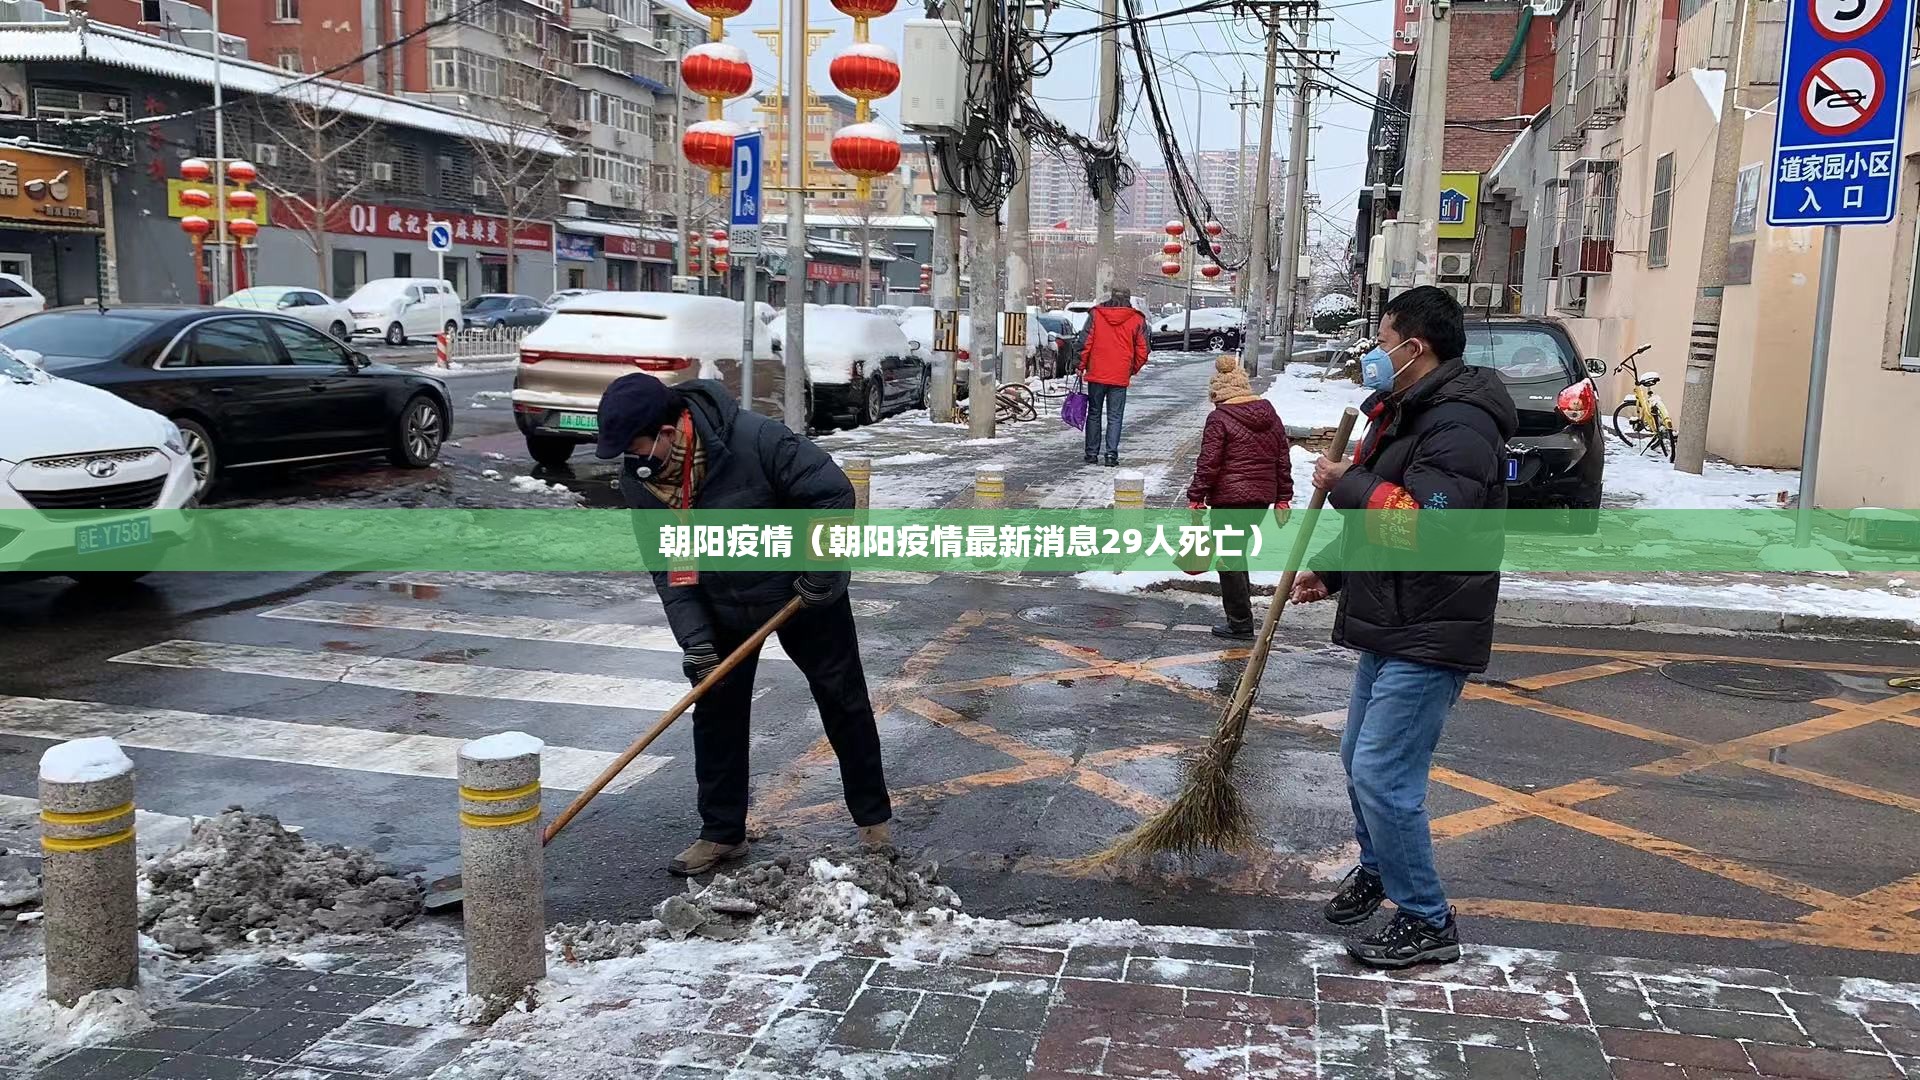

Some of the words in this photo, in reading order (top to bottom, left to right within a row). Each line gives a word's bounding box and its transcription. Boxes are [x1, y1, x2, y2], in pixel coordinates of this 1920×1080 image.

[736, 145, 753, 216] P
[1779, 151, 1892, 183] 道家园小区
[1798, 185, 1864, 213] 入口
[388, 210, 499, 244] 欧记麻辣烫
